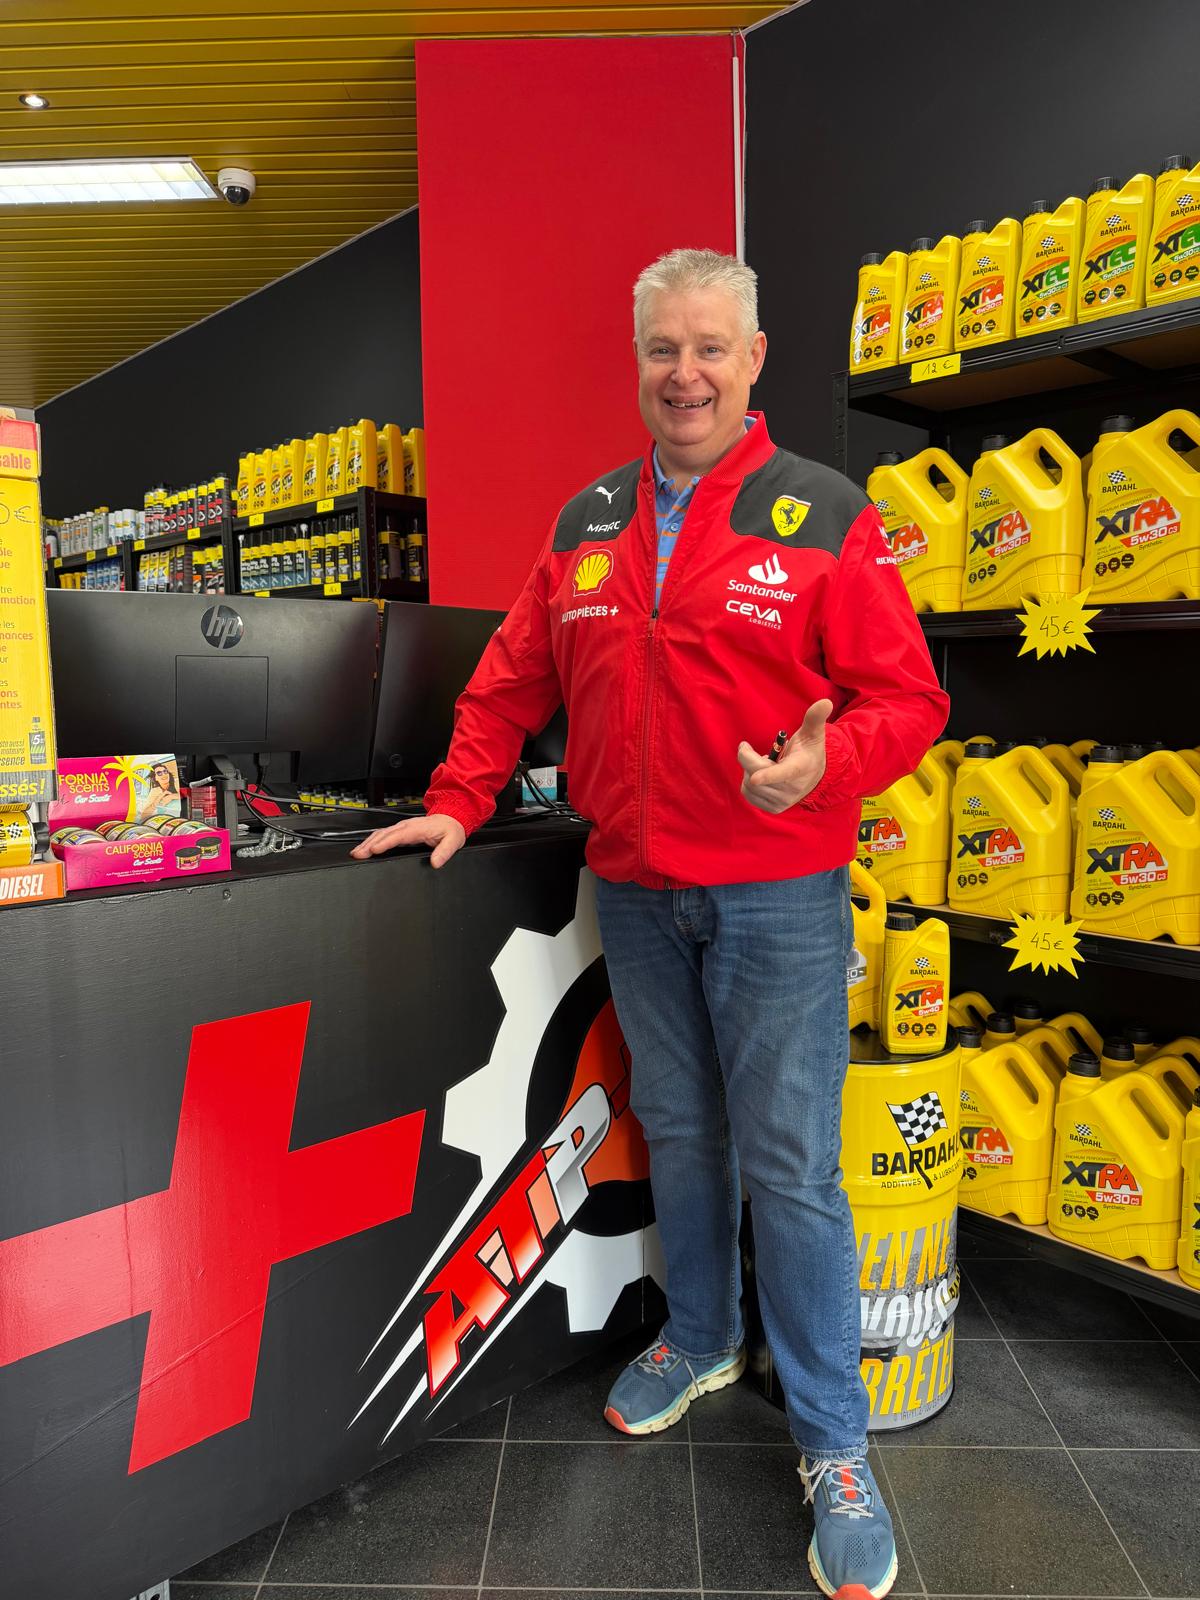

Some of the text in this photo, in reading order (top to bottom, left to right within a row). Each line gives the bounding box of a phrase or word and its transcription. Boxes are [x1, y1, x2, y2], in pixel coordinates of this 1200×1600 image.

[1100, 224, 1131, 236] BARDAHL
[1035, 246, 1064, 257] BARDAHL
[1082, 241, 1136, 281] XTEC
[972, 265, 1000, 276] BARDAHL
[1021, 260, 1069, 300] XTEC
[959, 279, 1004, 315] XTRA
[905, 294, 944, 328] XTRA
[1102, 483, 1137, 495] BARDAHL
[975, 499, 1000, 509] BARDAHL
[587, 520, 621, 533] MARC
[1095, 496, 1177, 544] XTRA
[969, 510, 1028, 554] XTRA
[1130, 527, 1168, 546] 5w30
[994, 539, 1021, 556] 5w30
[727, 579, 797, 602] Santander
[206, 606, 239, 649] hp
[749, 617, 781, 630] LOGISTICS
[962, 809, 991, 818] BARDAHL
[1092, 820, 1127, 831] BARDAHL
[105, 841, 163, 855] CALIFORNIA
[957, 827, 1021, 858] XTRA
[985, 854, 1014, 867] 5w30
[1086, 841, 1165, 875] XTRA
[1120, 872, 1156, 885] 5w30
[0, 874, 44, 900] DIESEL
[910, 969, 939, 978] BARDAHL
[895, 985, 944, 1011] XTRA
[1069, 1134, 1102, 1149] BARDAHL
[872, 1132, 960, 1188] BARDAHL
[973, 1154, 1003, 1164] 5w30
[1062, 1160, 1139, 1191] XTRA
[880, 1178, 921, 1189] ADDITIVES
[1095, 1192, 1130, 1205] 5w30
